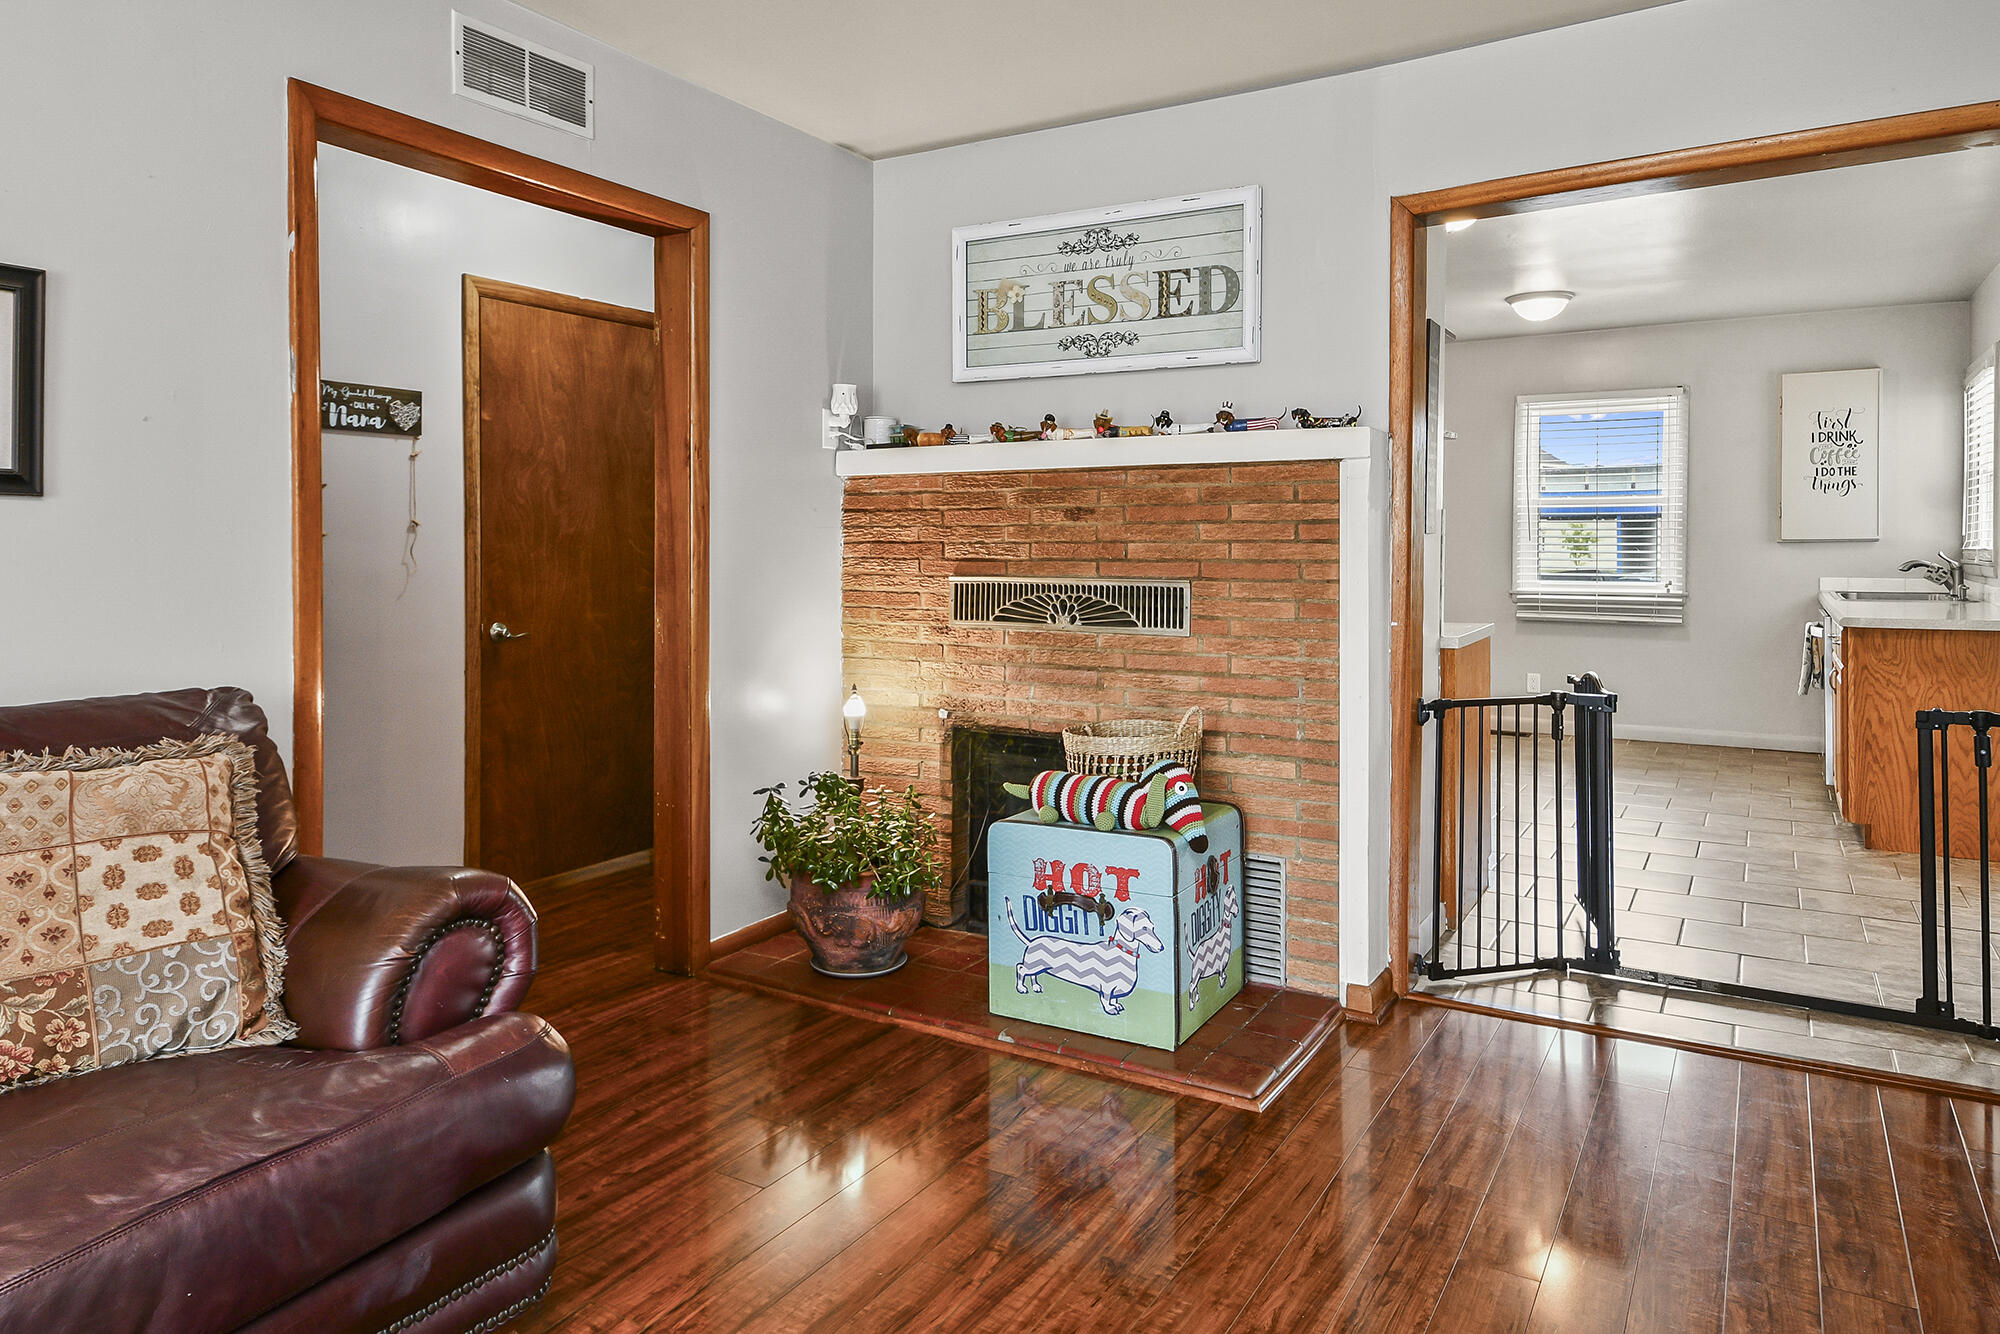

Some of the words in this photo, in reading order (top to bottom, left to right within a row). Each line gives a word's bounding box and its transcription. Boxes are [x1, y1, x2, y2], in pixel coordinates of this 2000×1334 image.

[1082, 258, 1100, 271] are
[1105, 250, 1134, 271] truly
[973, 264, 1240, 335] BLESSED
[1818, 429, 1864, 447] DRINK
[1809, 447, 1861, 466] Coffee
[1821, 467, 1836, 477] DO
[1837, 466, 1858, 477] THE
[1032, 857, 1140, 902] HOT
[1194, 849, 1232, 904] HT
